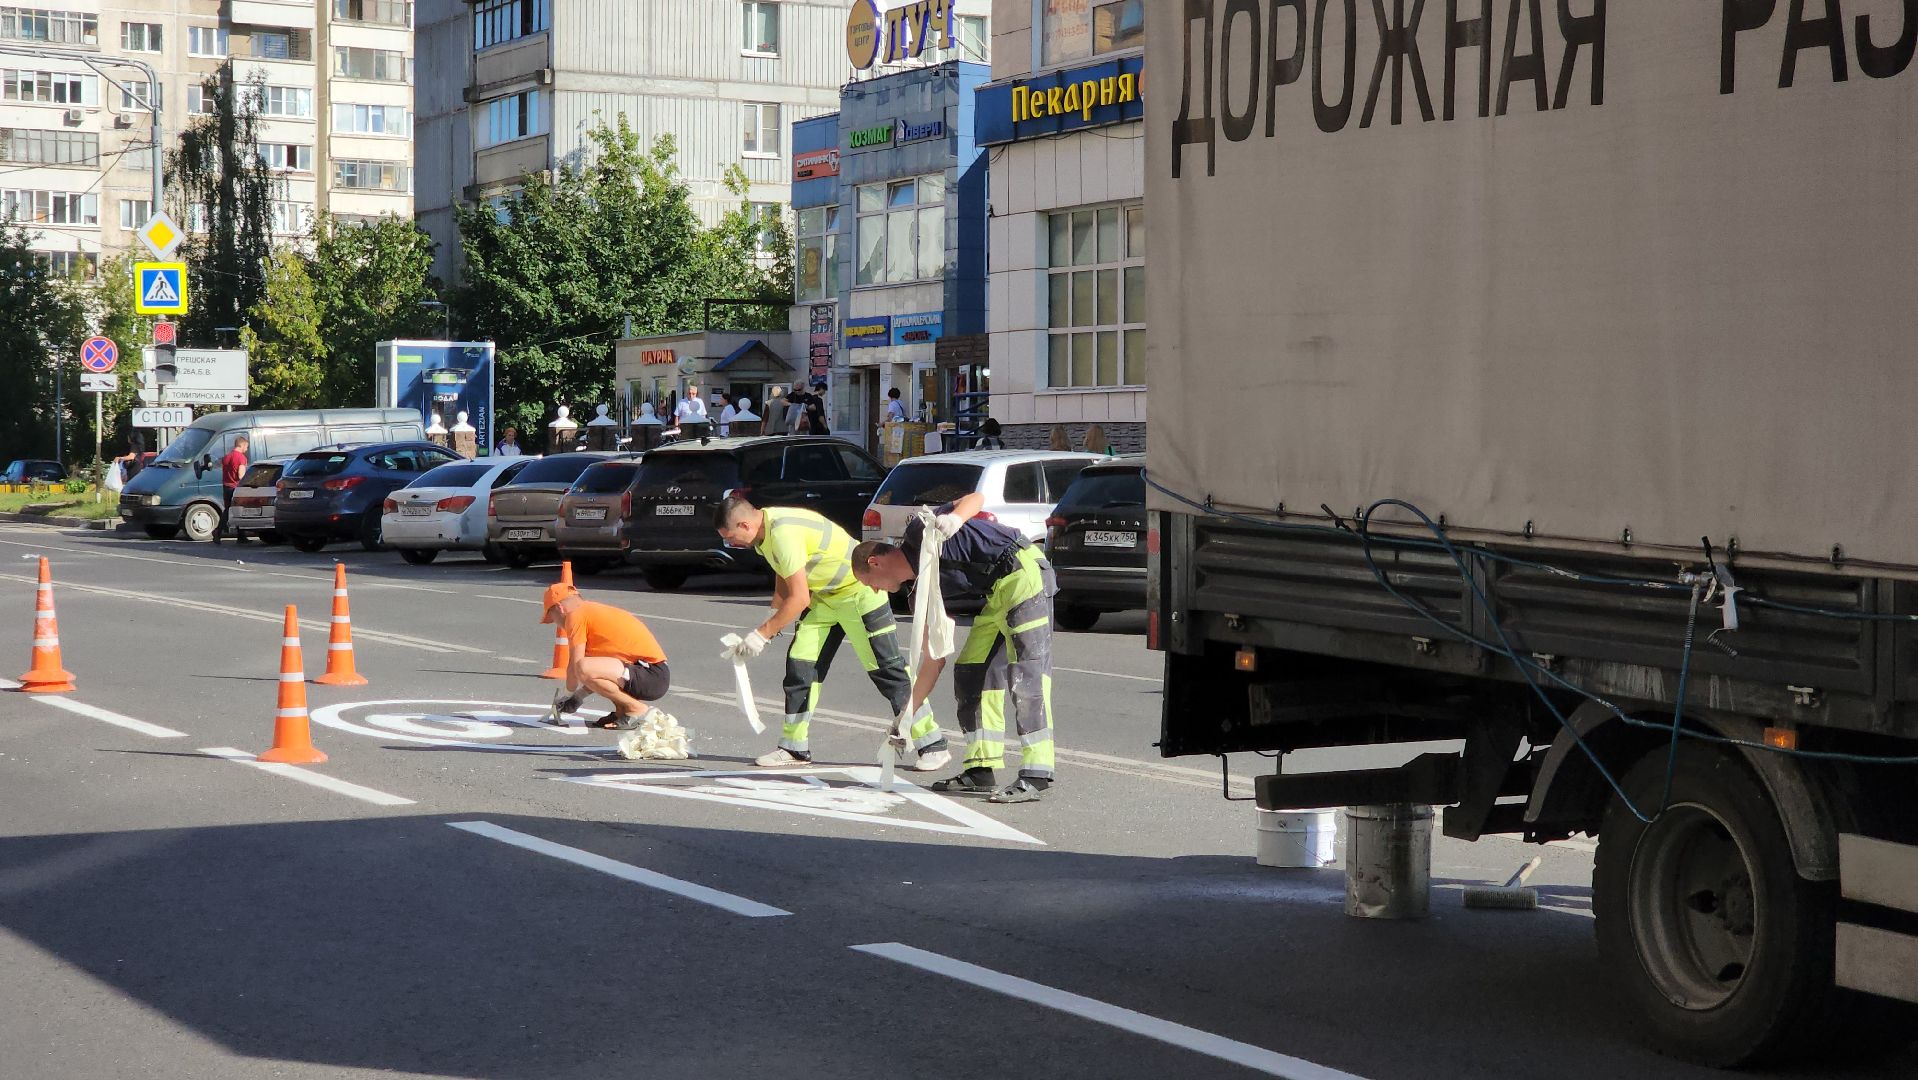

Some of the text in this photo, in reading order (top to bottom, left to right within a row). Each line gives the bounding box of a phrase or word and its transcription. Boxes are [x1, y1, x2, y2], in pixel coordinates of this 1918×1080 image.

[882, 0, 954, 64] ЛУЧ
[1012, 73, 1134, 122] Пекарня
[1171, 0, 1606, 178] ДОРОЖНАЯ
[176, 356, 216, 364] ГРЕШСКАЯ
[141, 411, 183, 423] СТОП
[478, 406, 486, 446] ARTEZIAN
